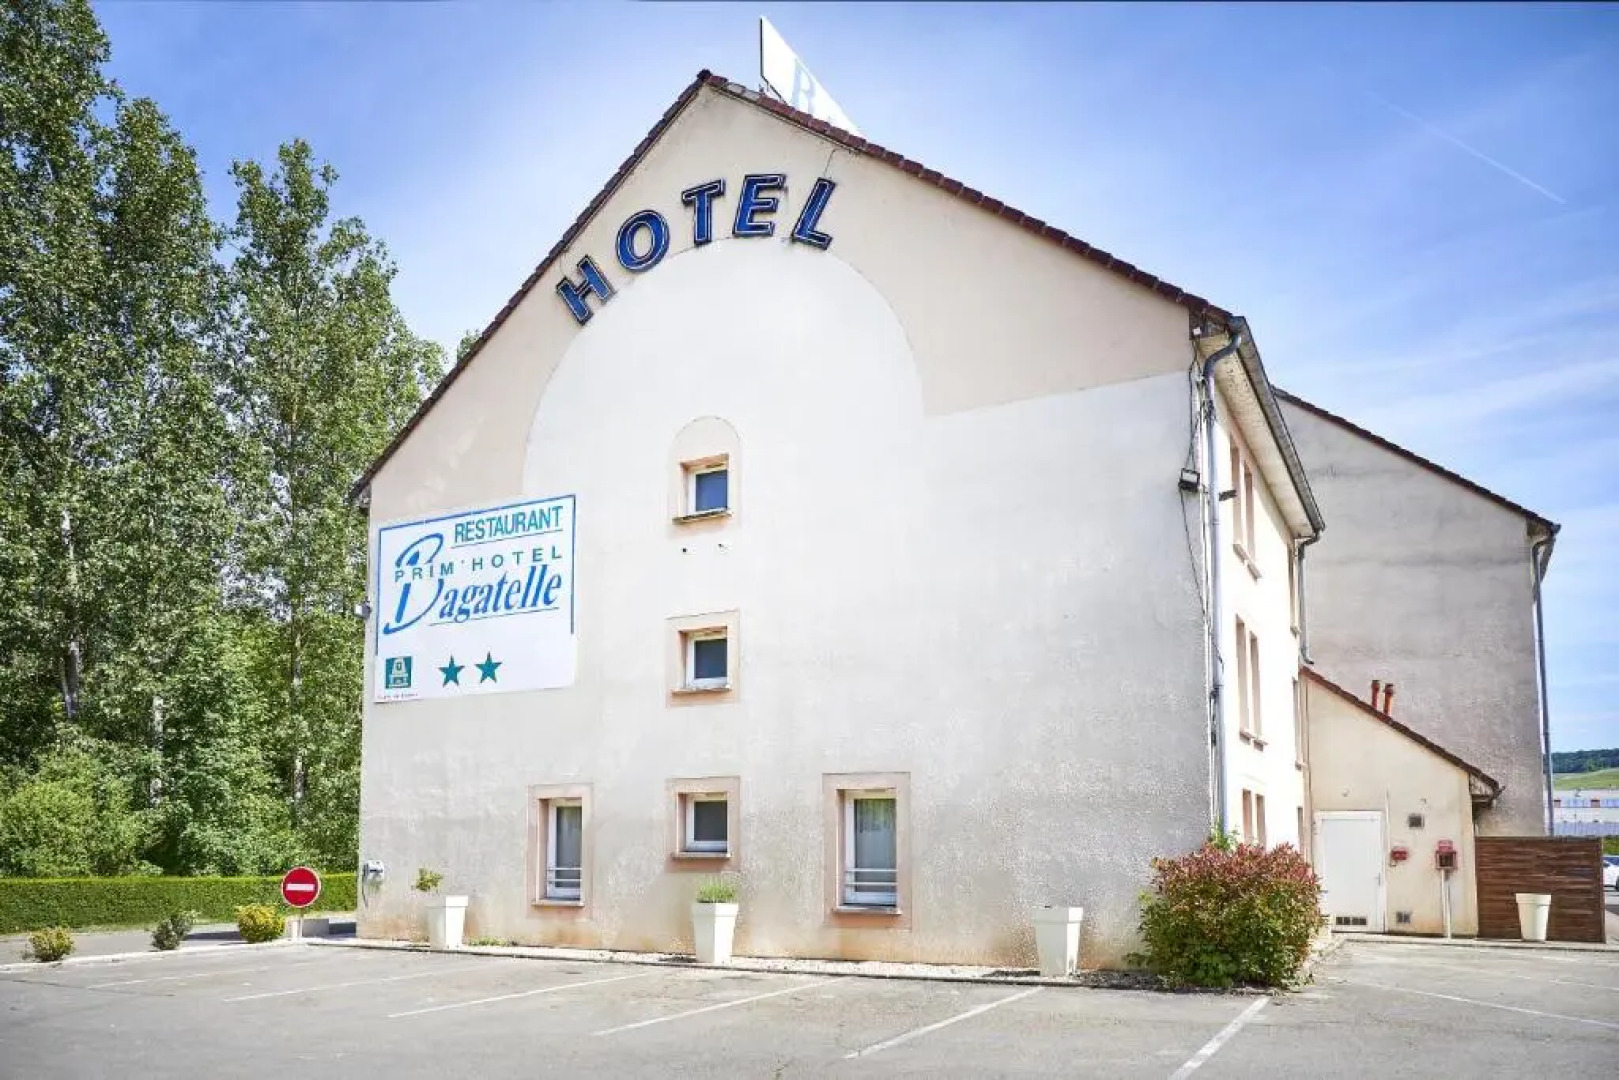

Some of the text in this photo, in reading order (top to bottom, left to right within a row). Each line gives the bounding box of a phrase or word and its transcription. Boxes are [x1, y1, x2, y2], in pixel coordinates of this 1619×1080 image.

[556, 173, 837, 326] HOTEL
[454, 505, 563, 543] RESTAURANT
[382, 532, 562, 635] Bagatelle
